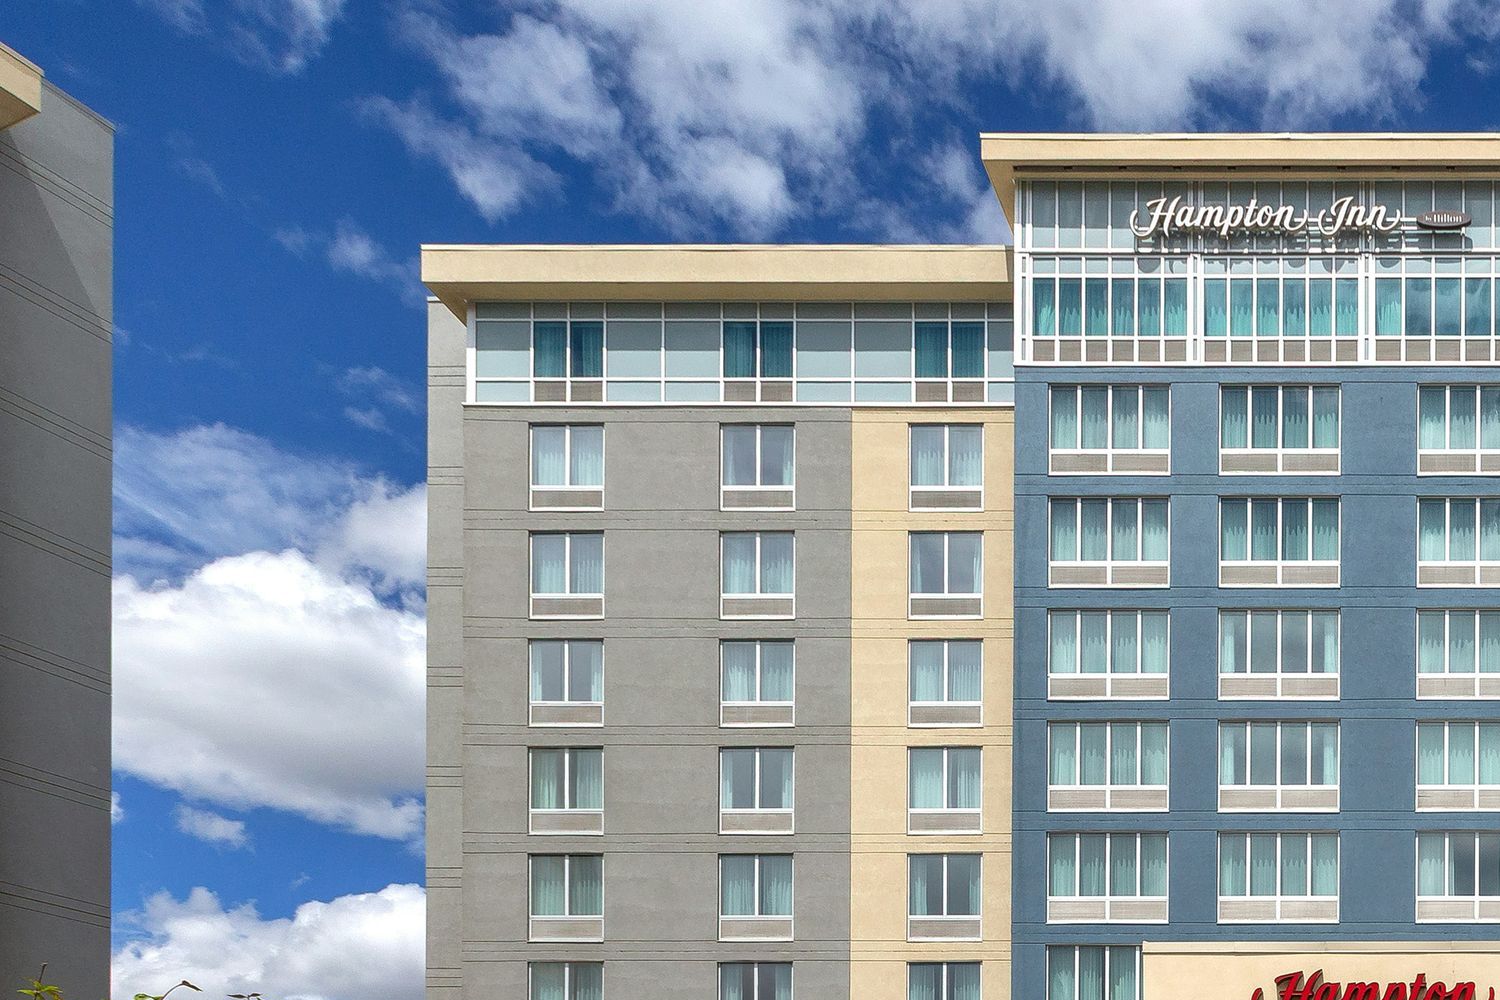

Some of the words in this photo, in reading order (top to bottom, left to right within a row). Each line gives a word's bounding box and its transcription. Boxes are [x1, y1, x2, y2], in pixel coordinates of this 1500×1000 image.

[1129, 195, 1309, 239] Hampton
[1318, 196, 1400, 236] Inn
[1433, 213, 1462, 223] Hilton
